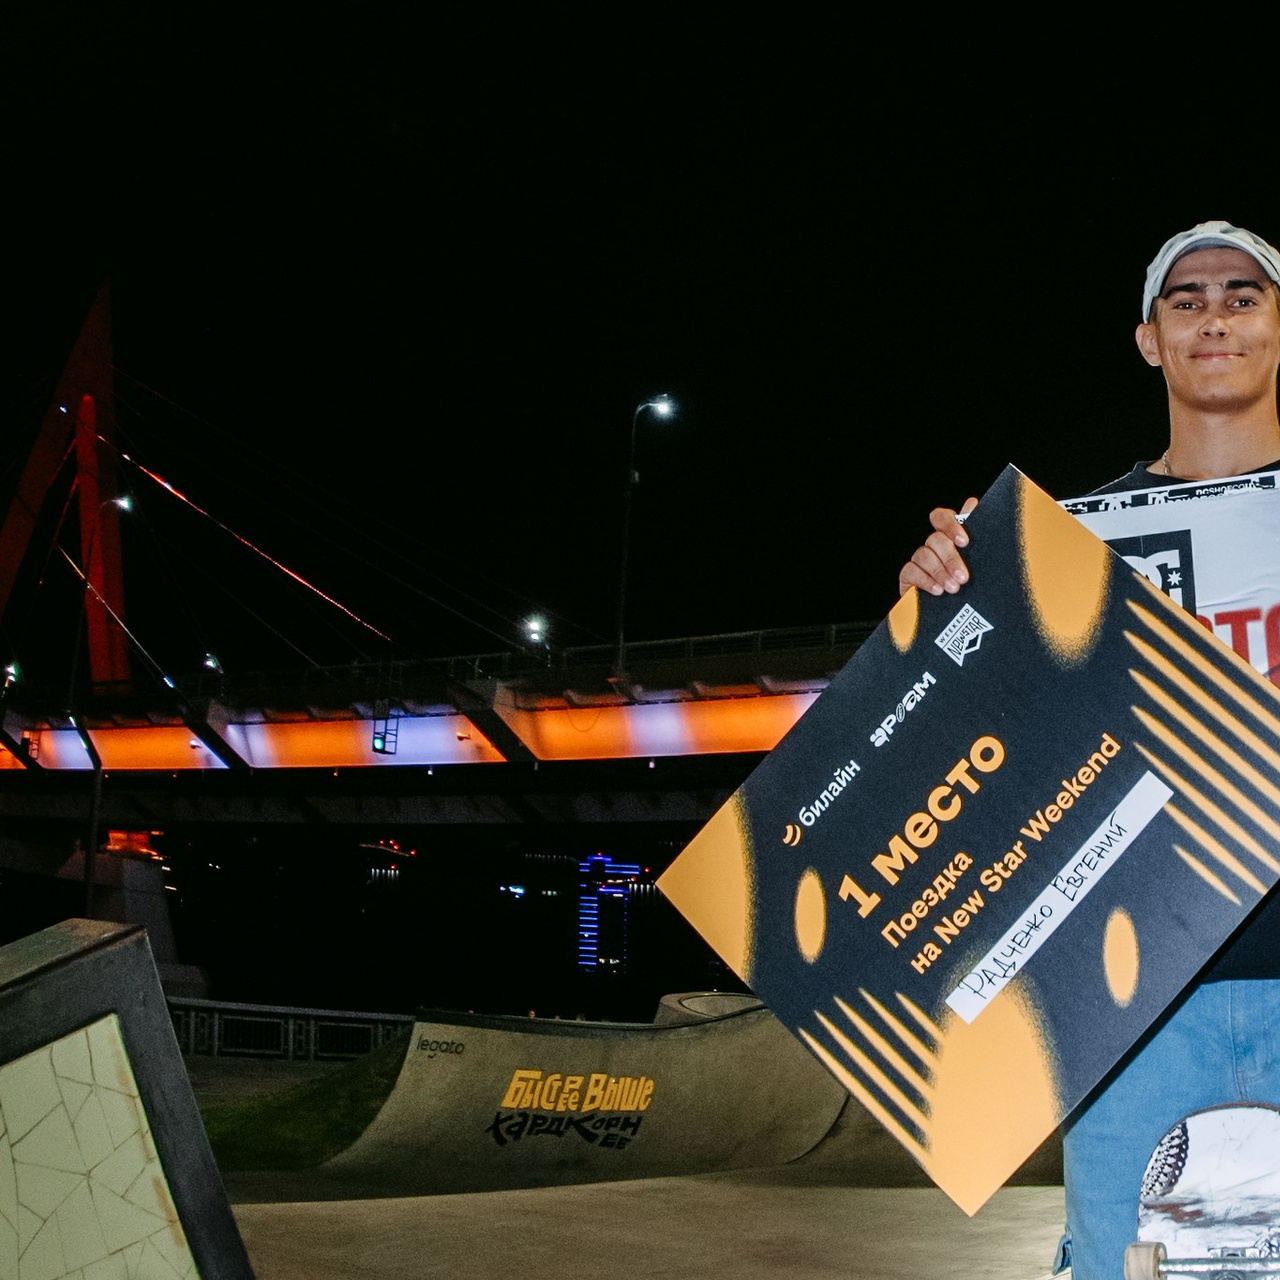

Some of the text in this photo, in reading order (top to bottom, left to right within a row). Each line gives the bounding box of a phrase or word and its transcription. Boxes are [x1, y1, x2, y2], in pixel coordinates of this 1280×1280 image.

[939, 608, 970, 644] WEEKEND
[799, 759, 861, 826] билайн
[910, 733, 1122, 974] на New Star Weekend
[838, 874, 882, 919] 1
[881, 852, 973, 948] Поездка
[416, 1034, 465, 1058] legato
